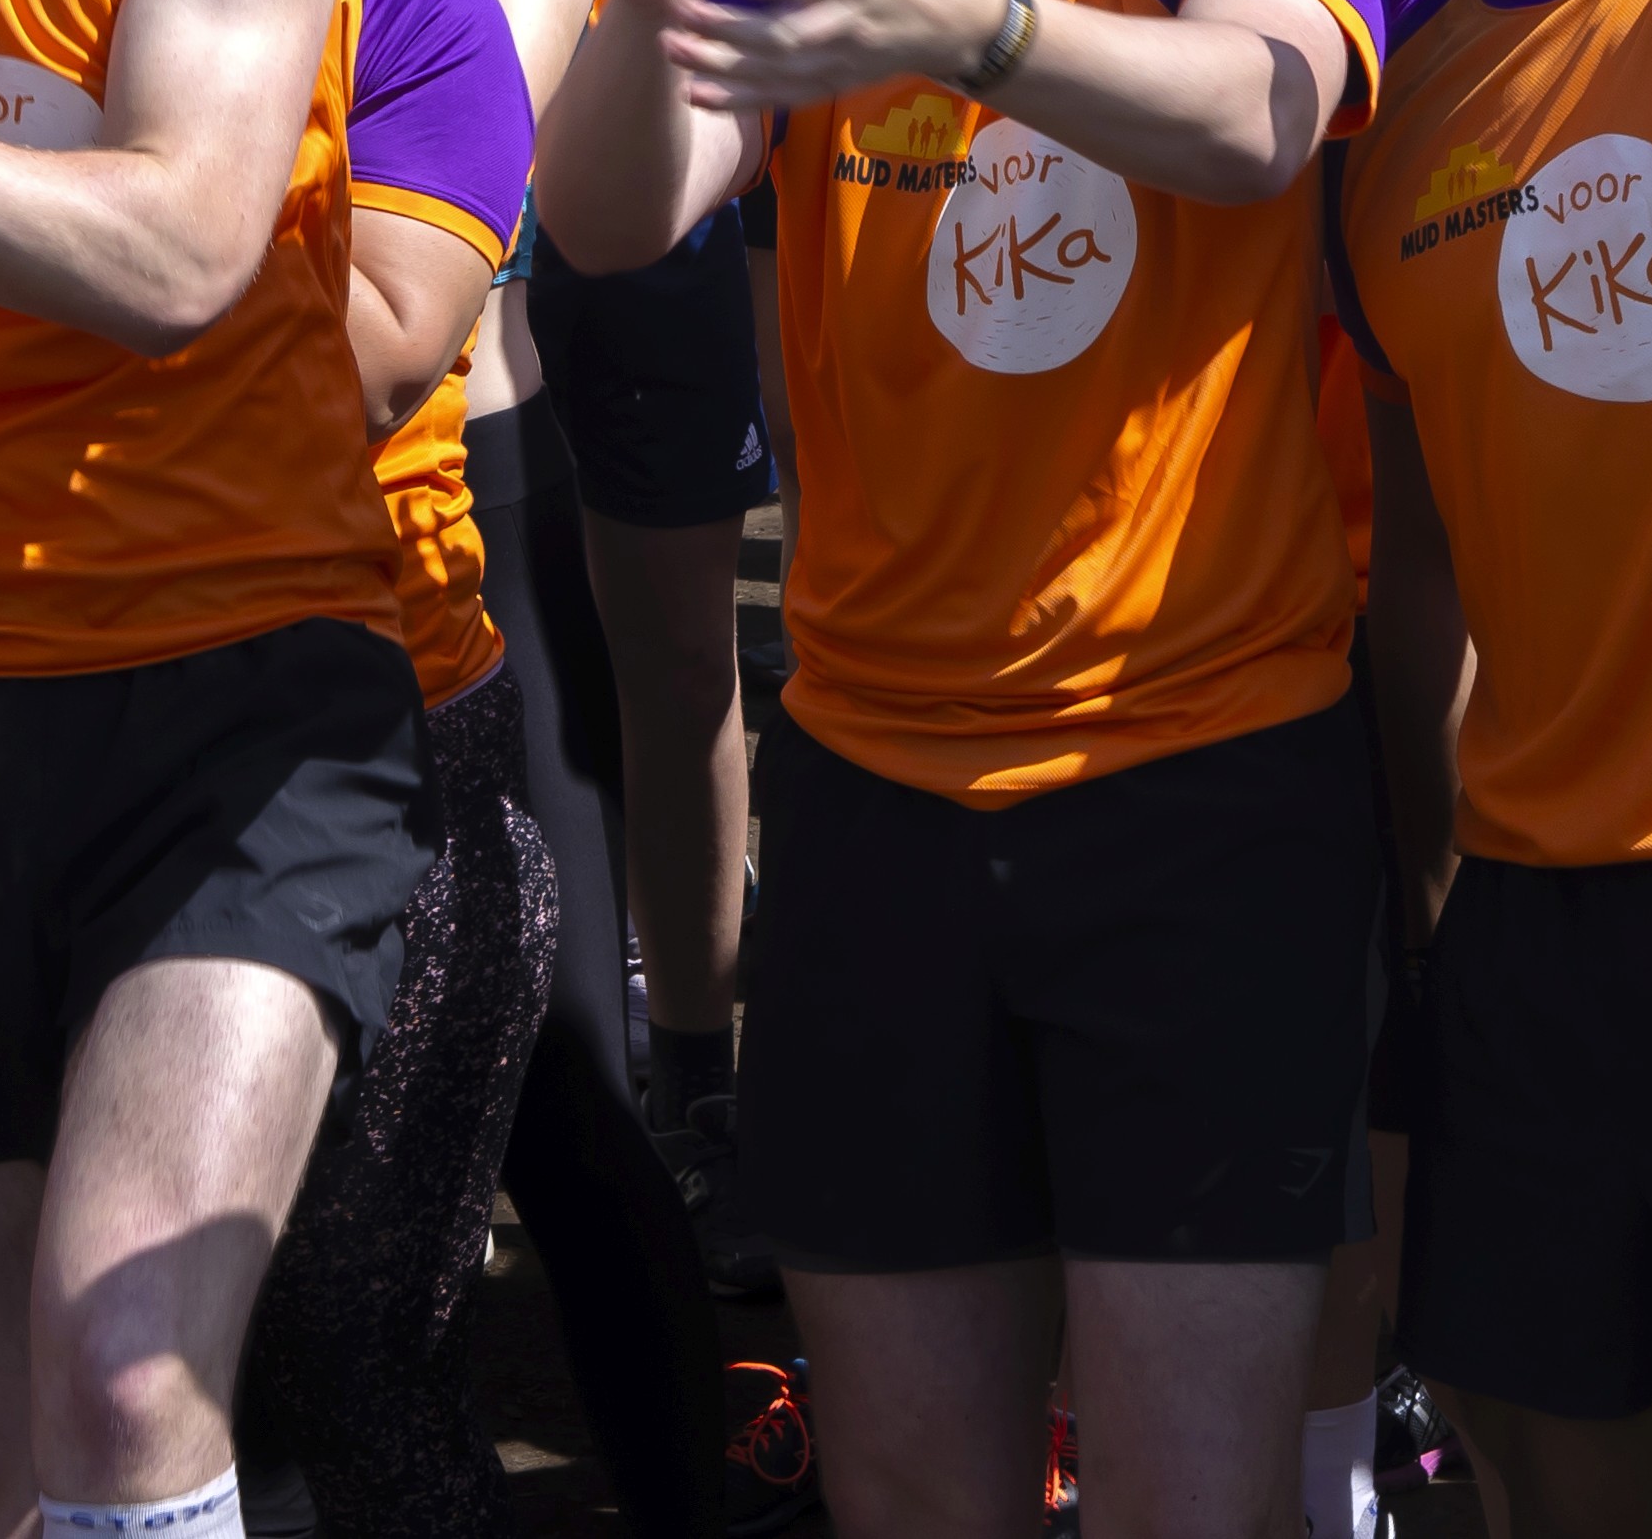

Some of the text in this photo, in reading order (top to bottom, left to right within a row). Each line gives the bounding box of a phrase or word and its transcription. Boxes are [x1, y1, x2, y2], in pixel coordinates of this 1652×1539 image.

[834, 153, 890, 188] MUD
[980, 150, 1063, 196] voor
[1400, 172, 1642, 263] MUD MASTERS voor
